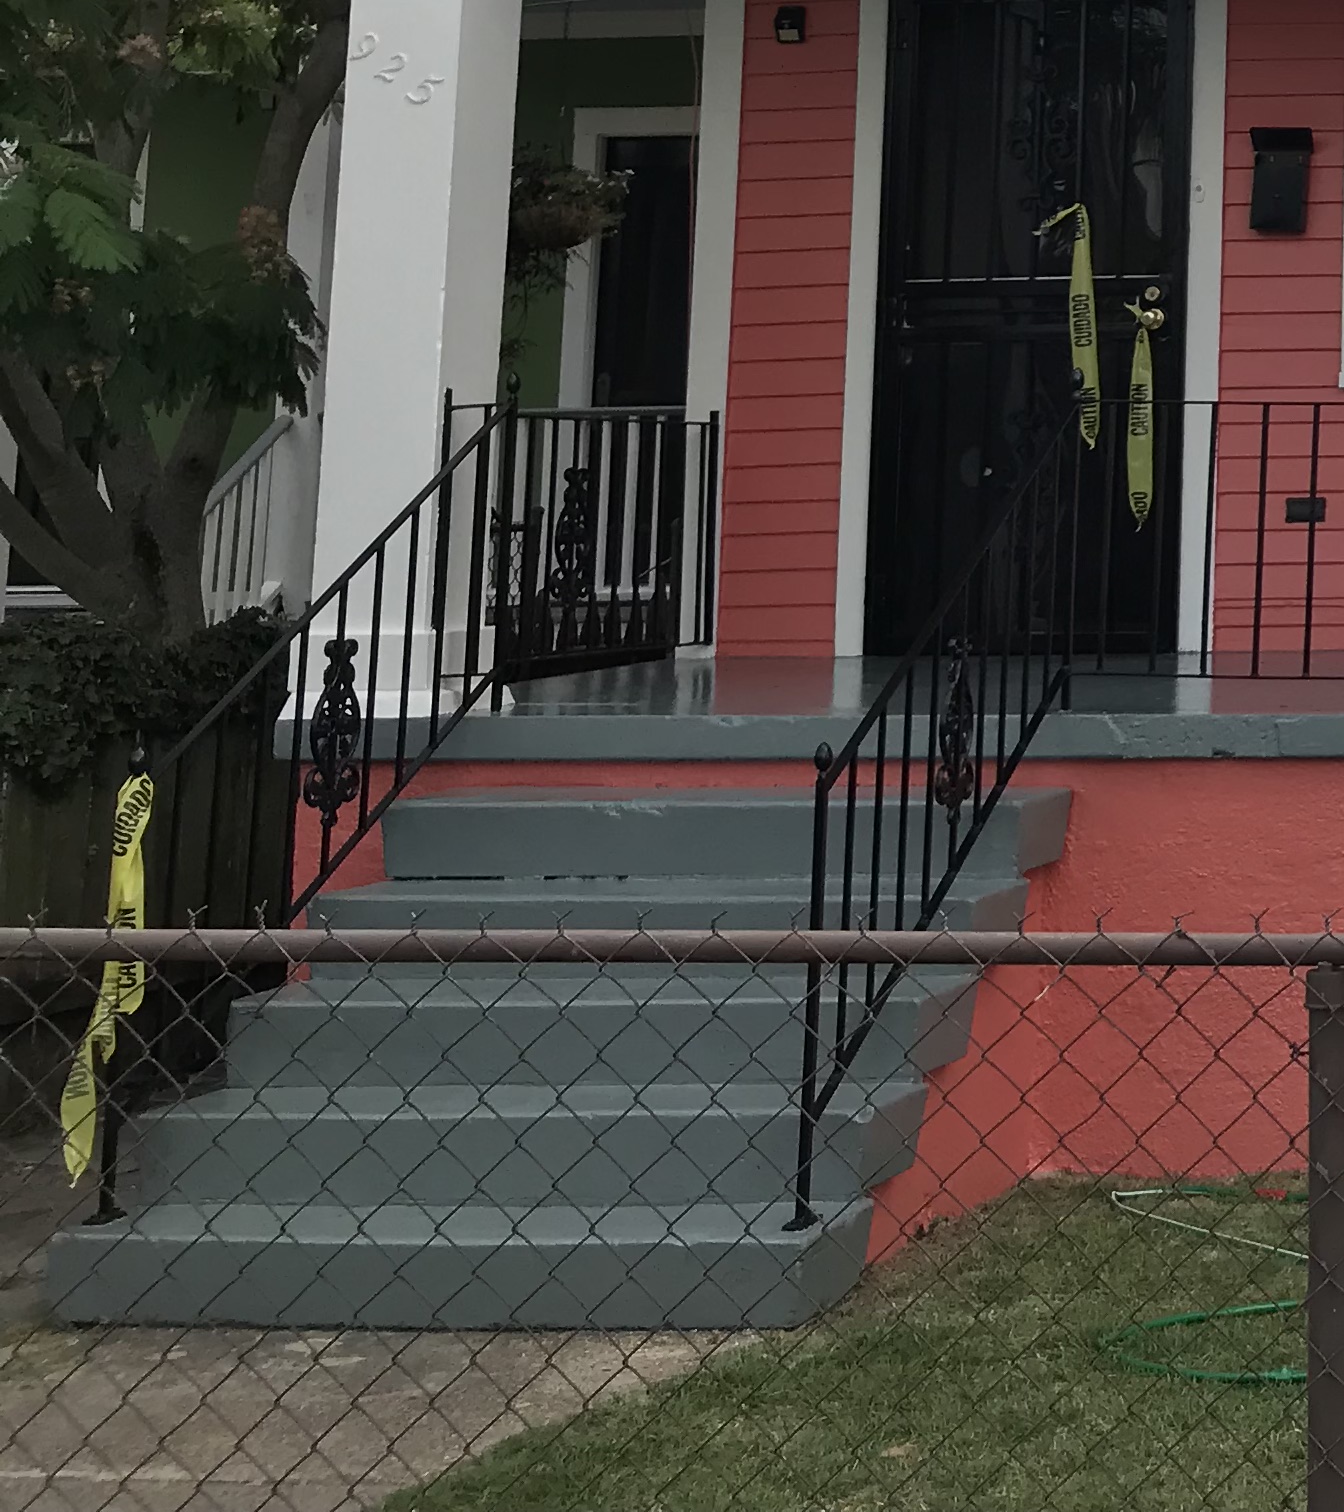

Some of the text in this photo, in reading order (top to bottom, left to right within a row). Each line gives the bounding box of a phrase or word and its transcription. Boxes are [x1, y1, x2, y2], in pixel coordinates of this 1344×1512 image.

[349, 31, 445, 105] 925
[1071, 292, 1092, 347] CUIDADO
[1130, 384, 1149, 436] CAUTON
[112, 778, 151, 857] CUIDADO
